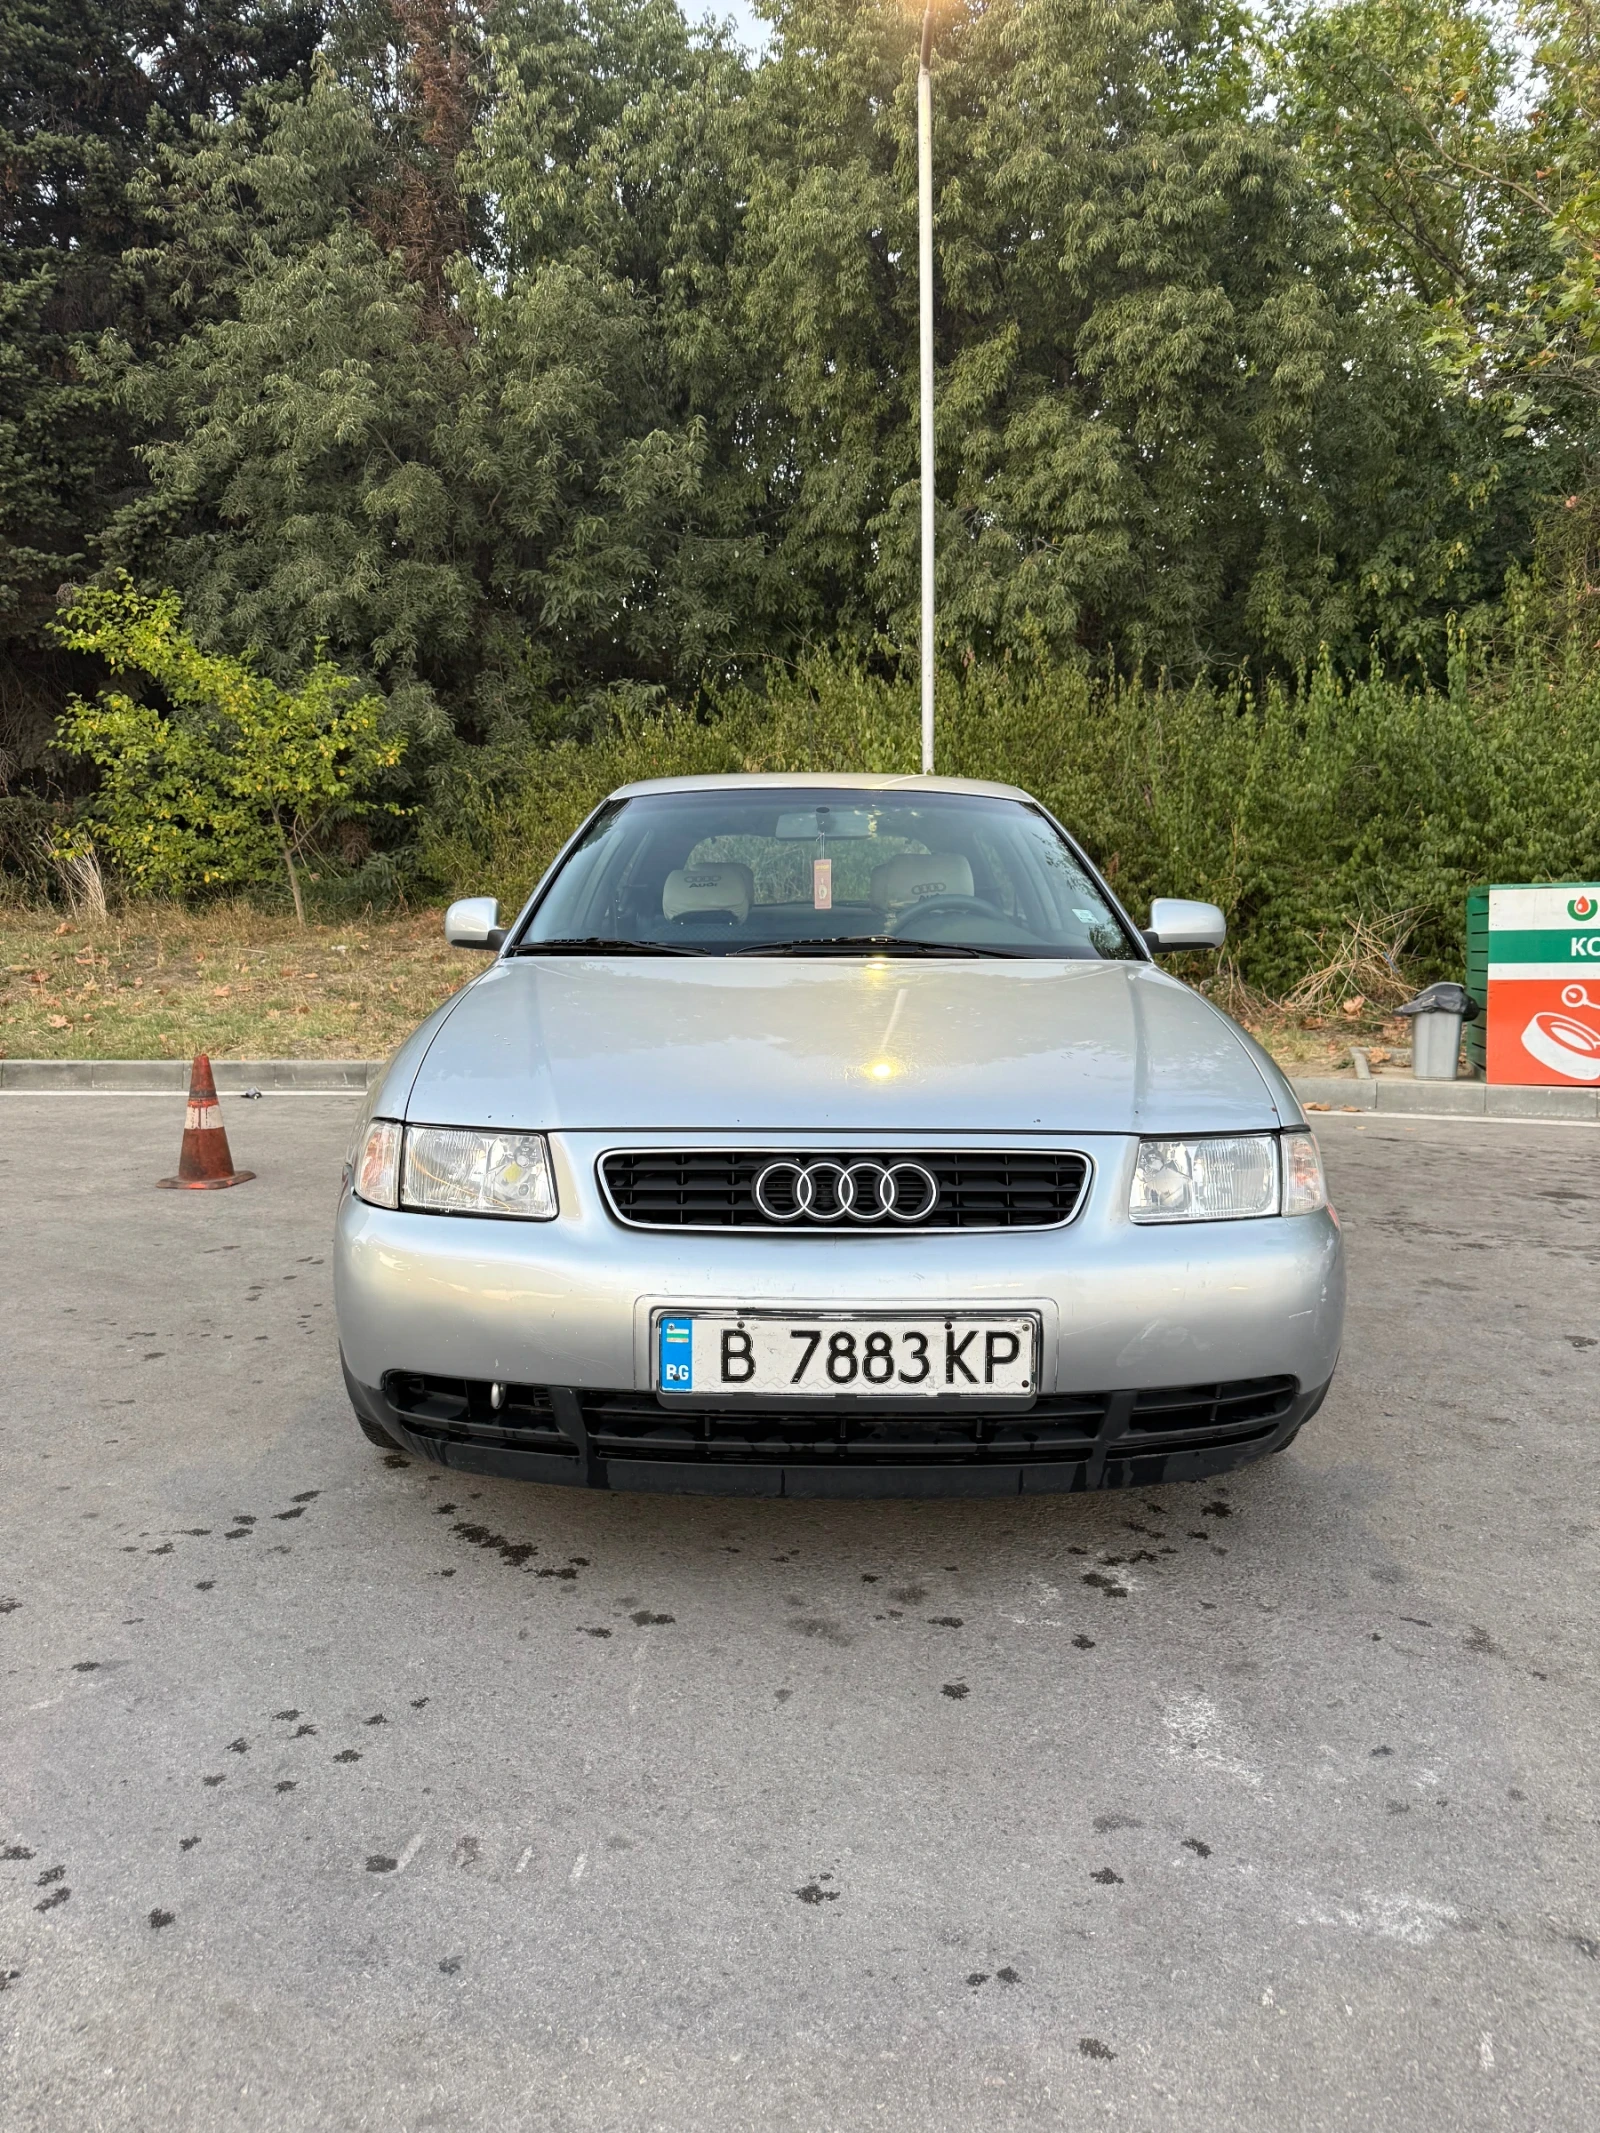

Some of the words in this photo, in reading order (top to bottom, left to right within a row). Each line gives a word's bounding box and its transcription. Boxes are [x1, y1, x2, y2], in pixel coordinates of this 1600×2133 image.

[666, 1363, 690, 1381] BG
[720, 1329, 756, 1384] B
[789, 1329, 930, 1385] 7883
[944, 1329, 1021, 1385] KP
